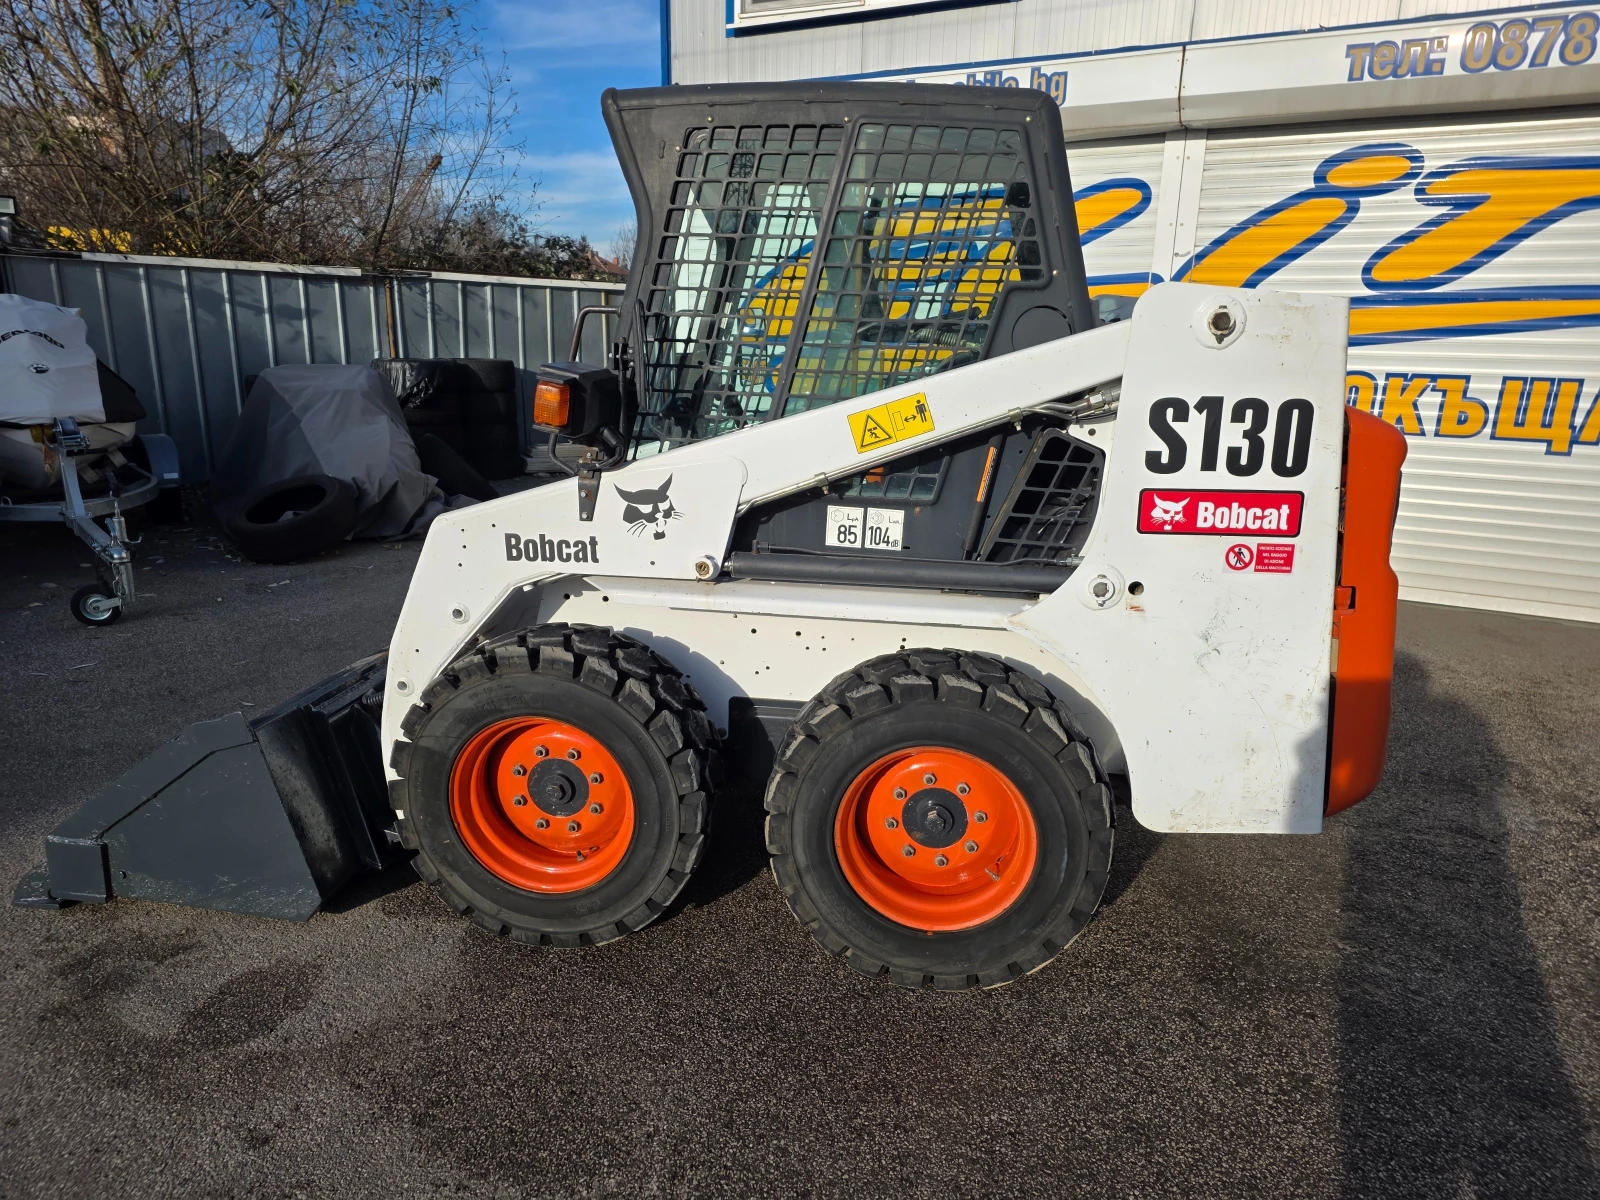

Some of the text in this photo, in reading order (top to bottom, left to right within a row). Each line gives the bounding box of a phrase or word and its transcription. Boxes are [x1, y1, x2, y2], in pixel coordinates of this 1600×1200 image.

[1460, 12, 1600, 73] 0878
[1144, 395, 1315, 478] S130
[1196, 501, 1290, 531] Bobcat
[504, 532, 599, 564] Bobcat
[837, 524, 857, 544] 85
[868, 526, 890, 546] 104
